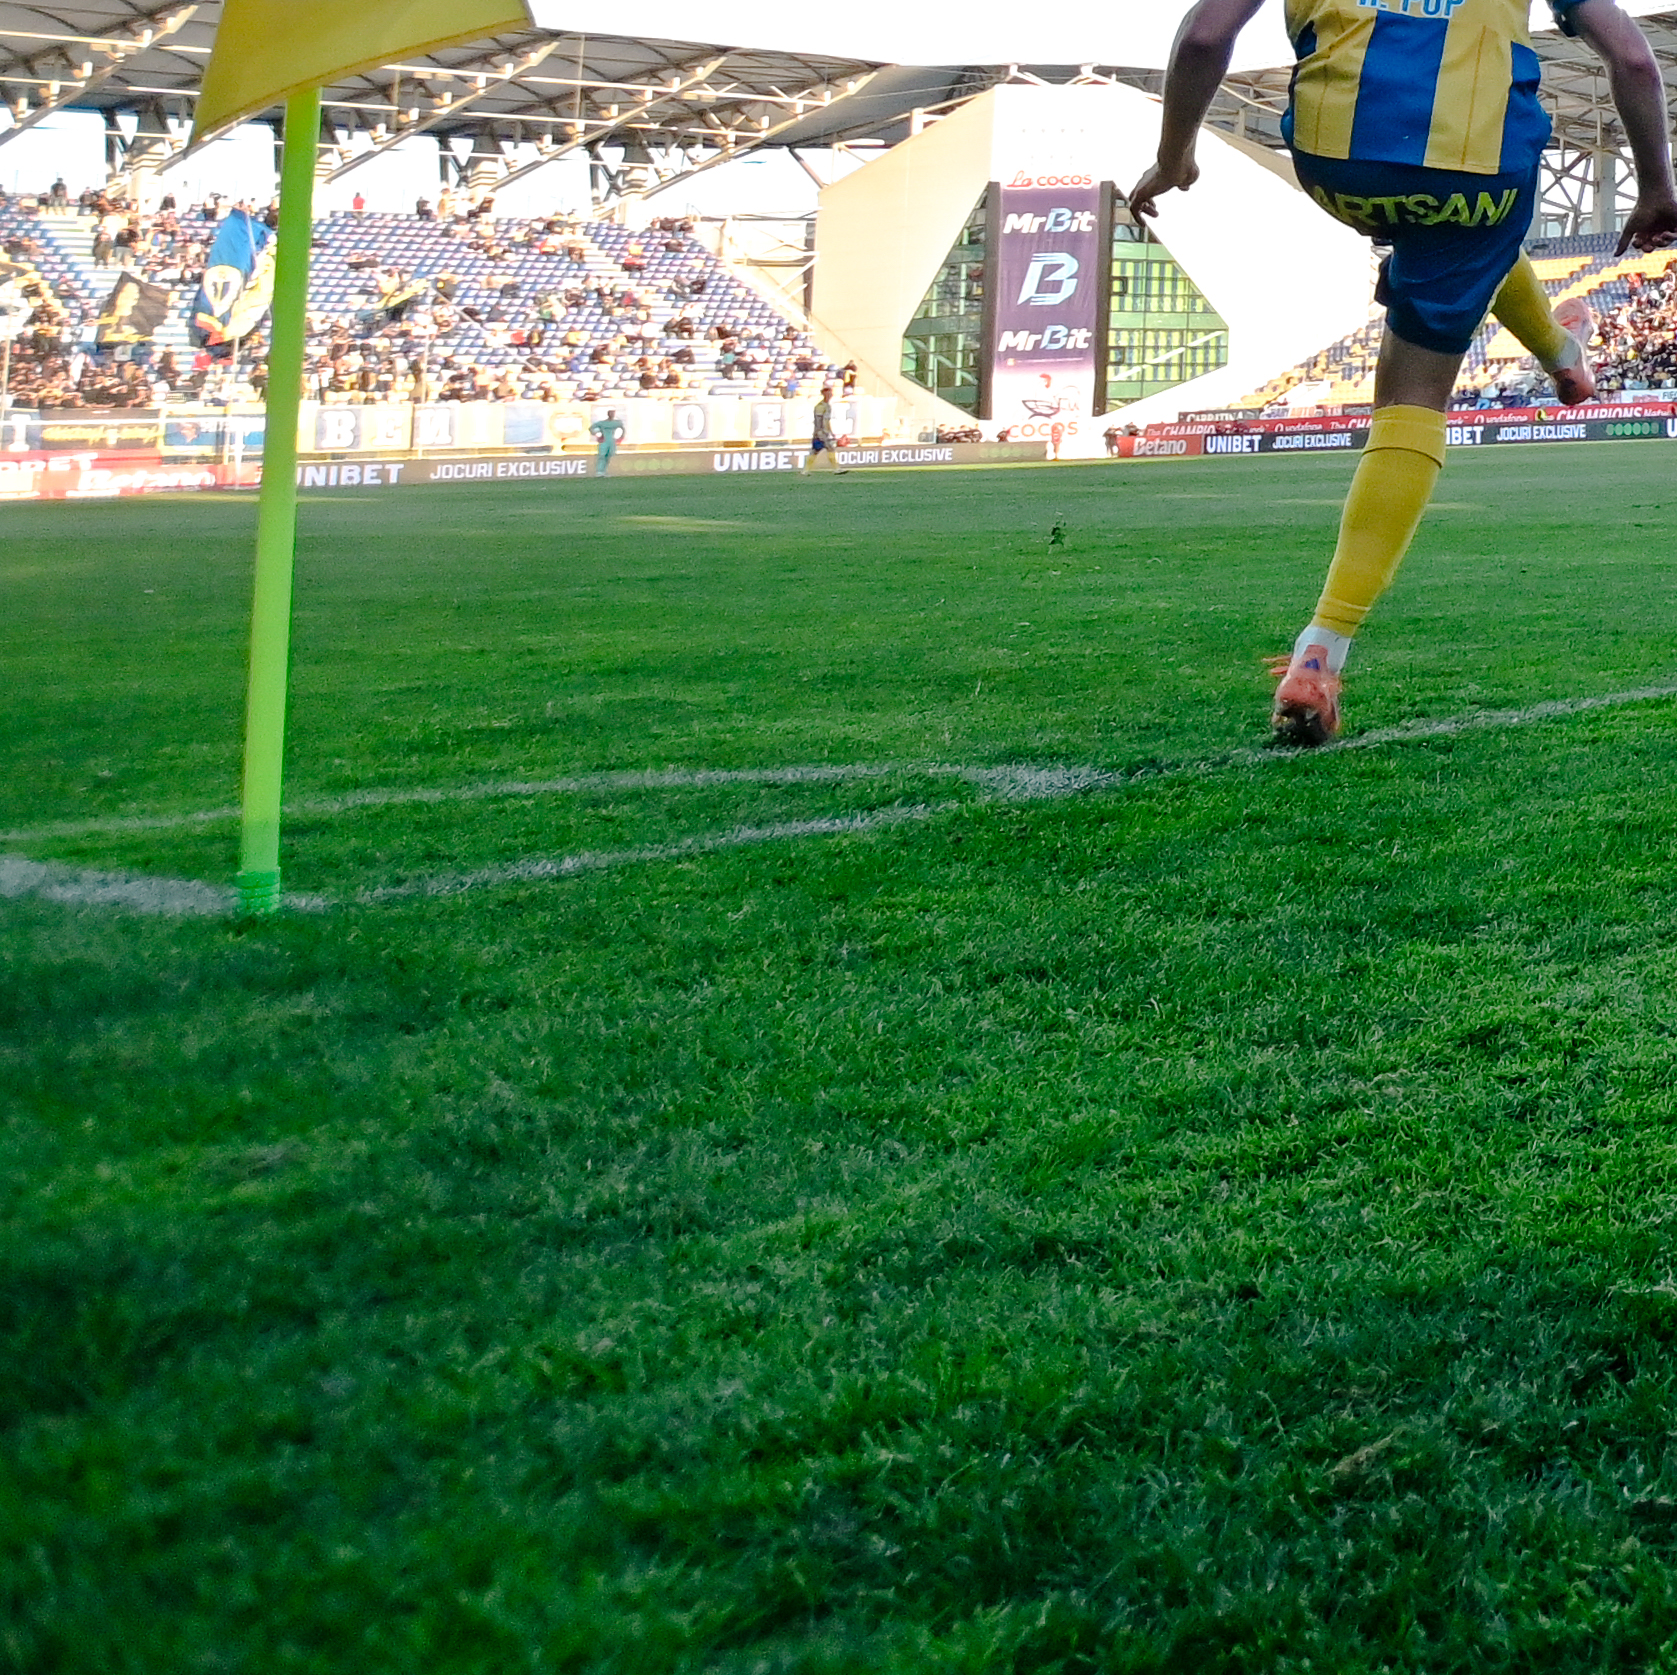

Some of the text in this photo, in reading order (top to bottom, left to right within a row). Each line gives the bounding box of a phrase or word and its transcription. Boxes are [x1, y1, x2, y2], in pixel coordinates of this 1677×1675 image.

[1003, 207, 1097, 234] MrBit
[997, 325, 1092, 352] MrBit
[1206, 435, 1262, 453] UNIBET
[1304, 432, 1352, 448] EXCLUSIVE
[1496, 427, 1532, 441] JOCURI
[1533, 424, 1587, 440] EXCLUSIVE
[1133, 436, 1187, 456] Betano
[713, 451, 811, 472] UNIBET
[881, 447, 953, 463] EXCLUSIVE
[301, 459, 587, 487] NIBET JOCURI EXCLUSIVE
